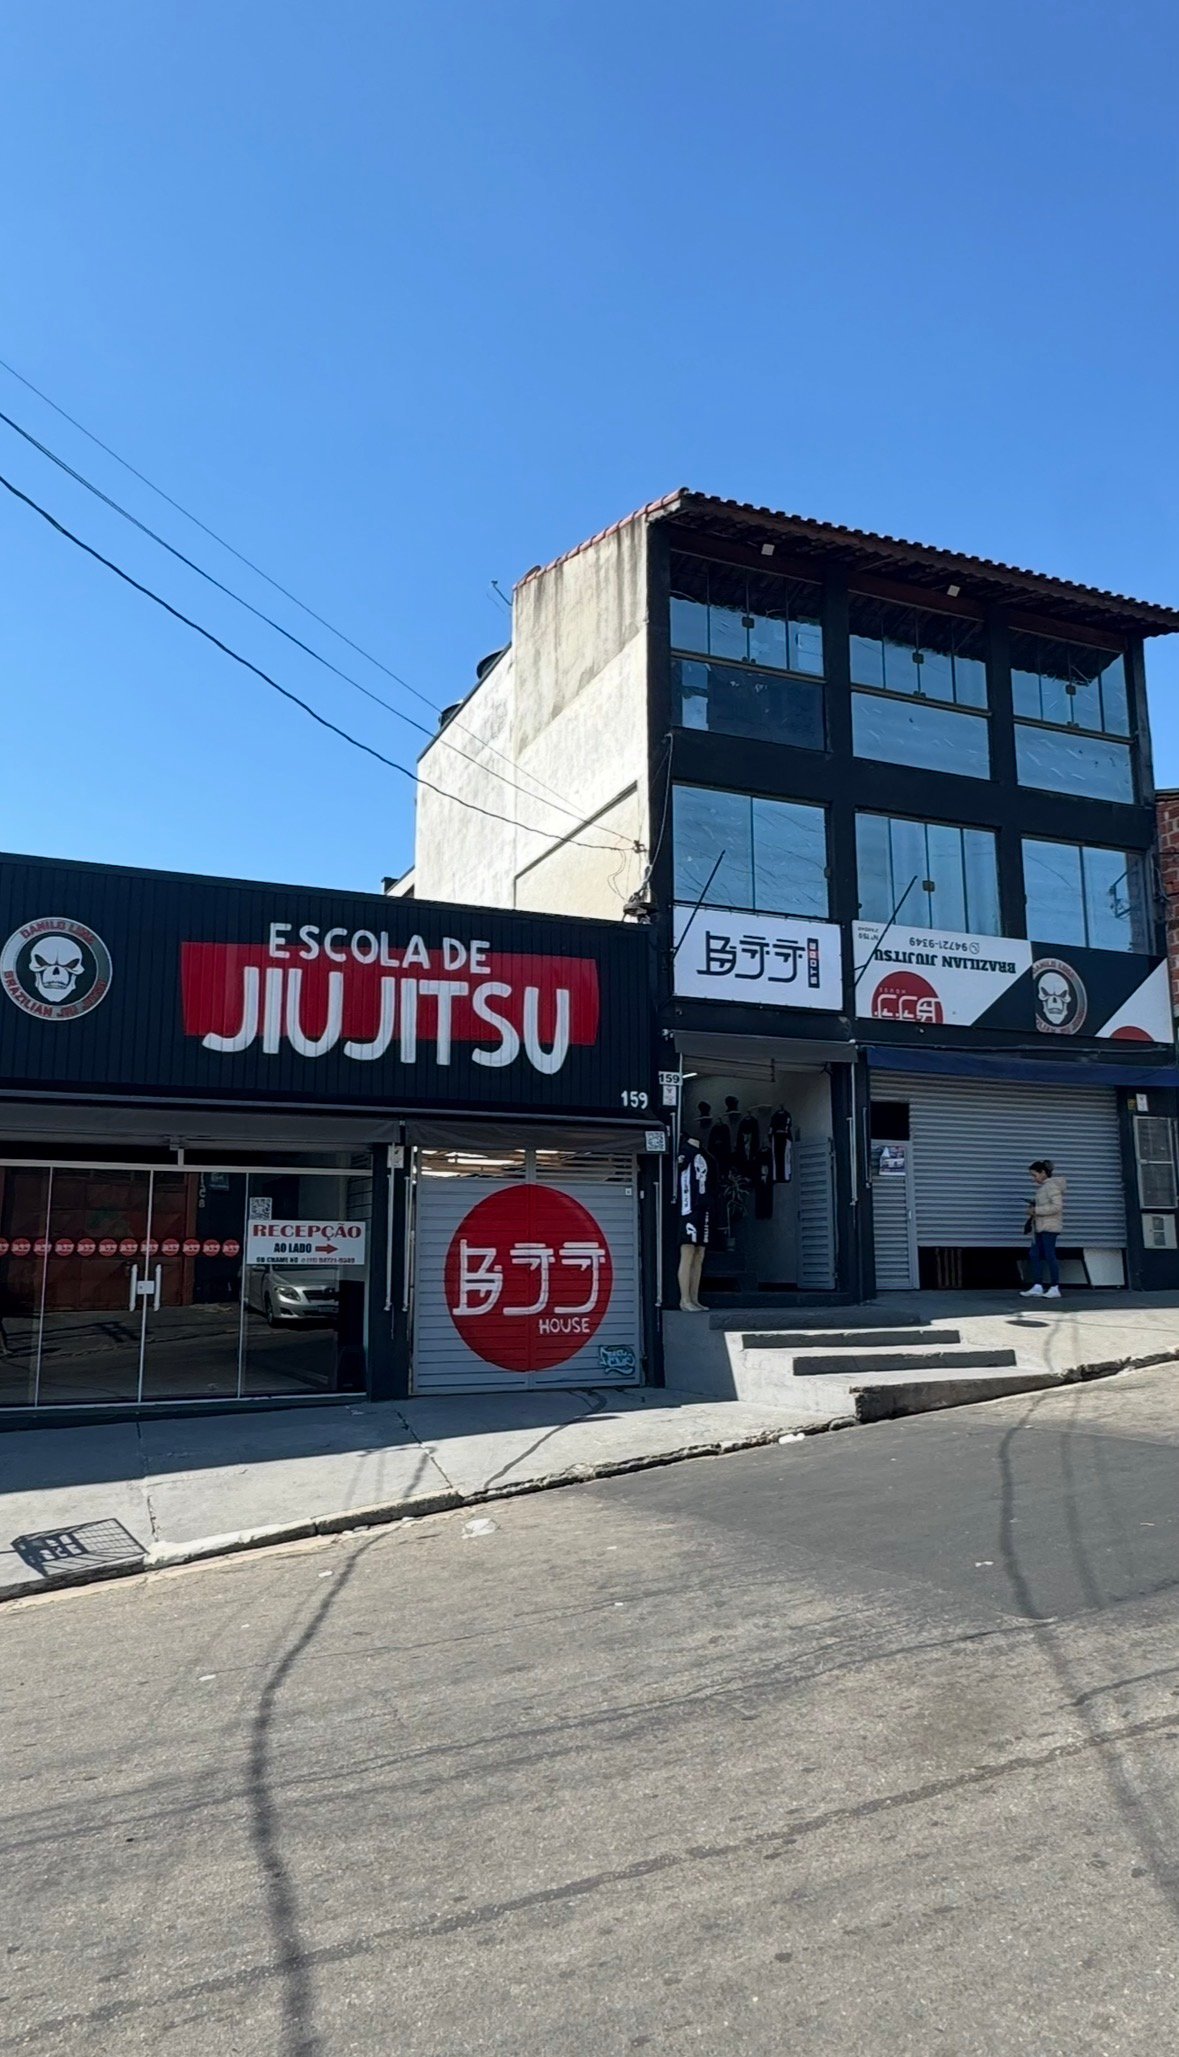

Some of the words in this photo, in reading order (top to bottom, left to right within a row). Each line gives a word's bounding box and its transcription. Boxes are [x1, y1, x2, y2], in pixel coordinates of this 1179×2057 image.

[20, 921, 66, 939] DANILO
[268, 922, 431, 968] ESCOLA
[442, 937, 492, 974] DE
[909, 937, 968, 952] 94721-9349
[874, 948, 939, 966] JIUJITSU
[942, 956, 1017, 974] BRAZILIAN
[4, 970, 53, 1016] BRAZILIAN
[659, 1073, 680, 1084] 159
[621, 1090, 649, 1110] 159
[253, 1223, 362, 1241] RECEPÇÃO
[273, 1243, 287, 1253] AO
[288, 1243, 312, 1253] LADO
[538, 1317, 590, 1334] HOUSE
